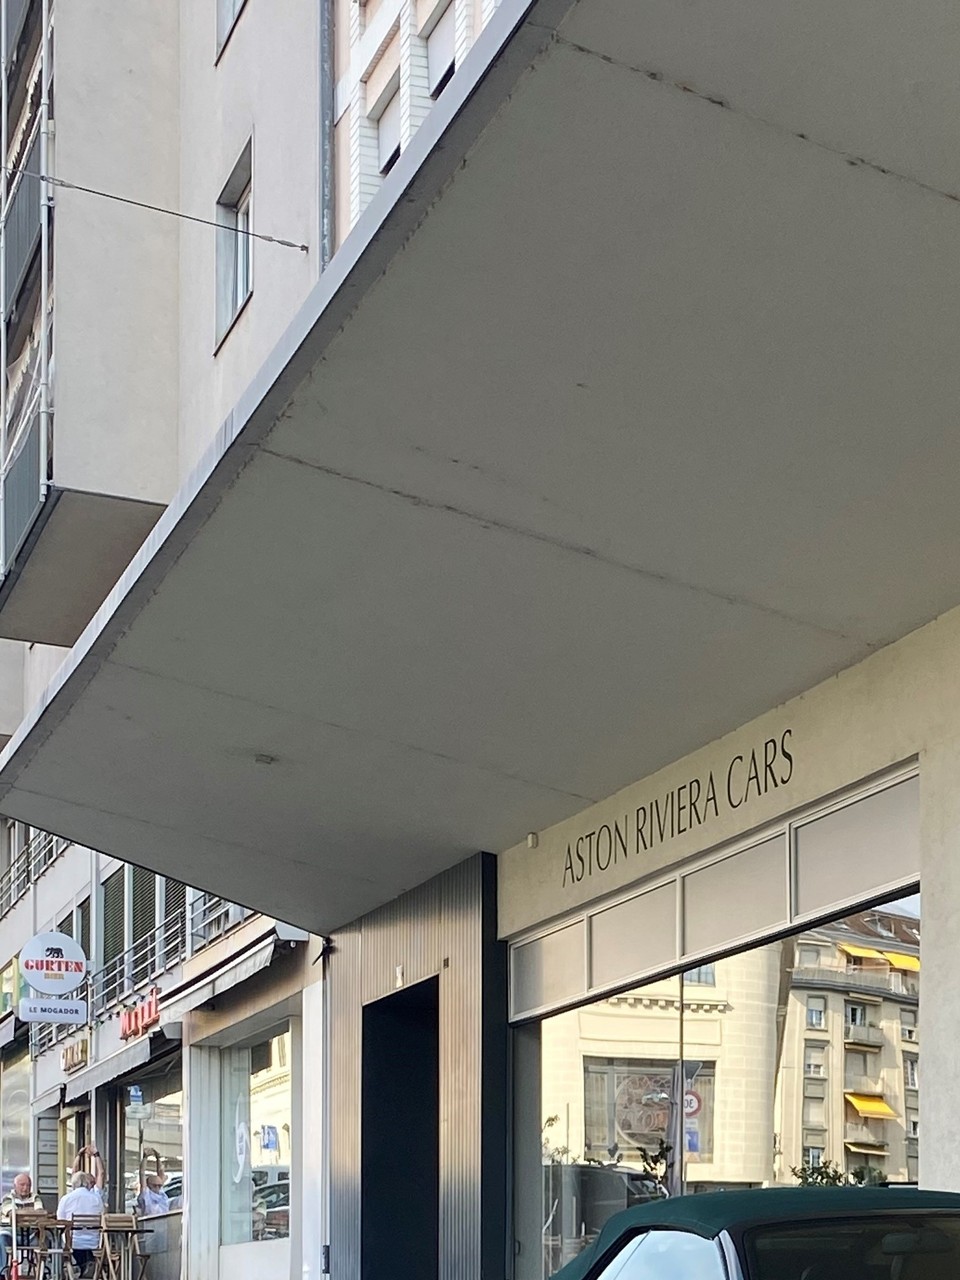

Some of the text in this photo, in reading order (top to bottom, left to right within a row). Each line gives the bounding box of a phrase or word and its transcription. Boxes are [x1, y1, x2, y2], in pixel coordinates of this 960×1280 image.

[562, 728, 794, 888] ASTON RIVIERA CARS
[24, 960, 84, 973] GURTEN
[40, 1007, 80, 1015] MOGADOR
